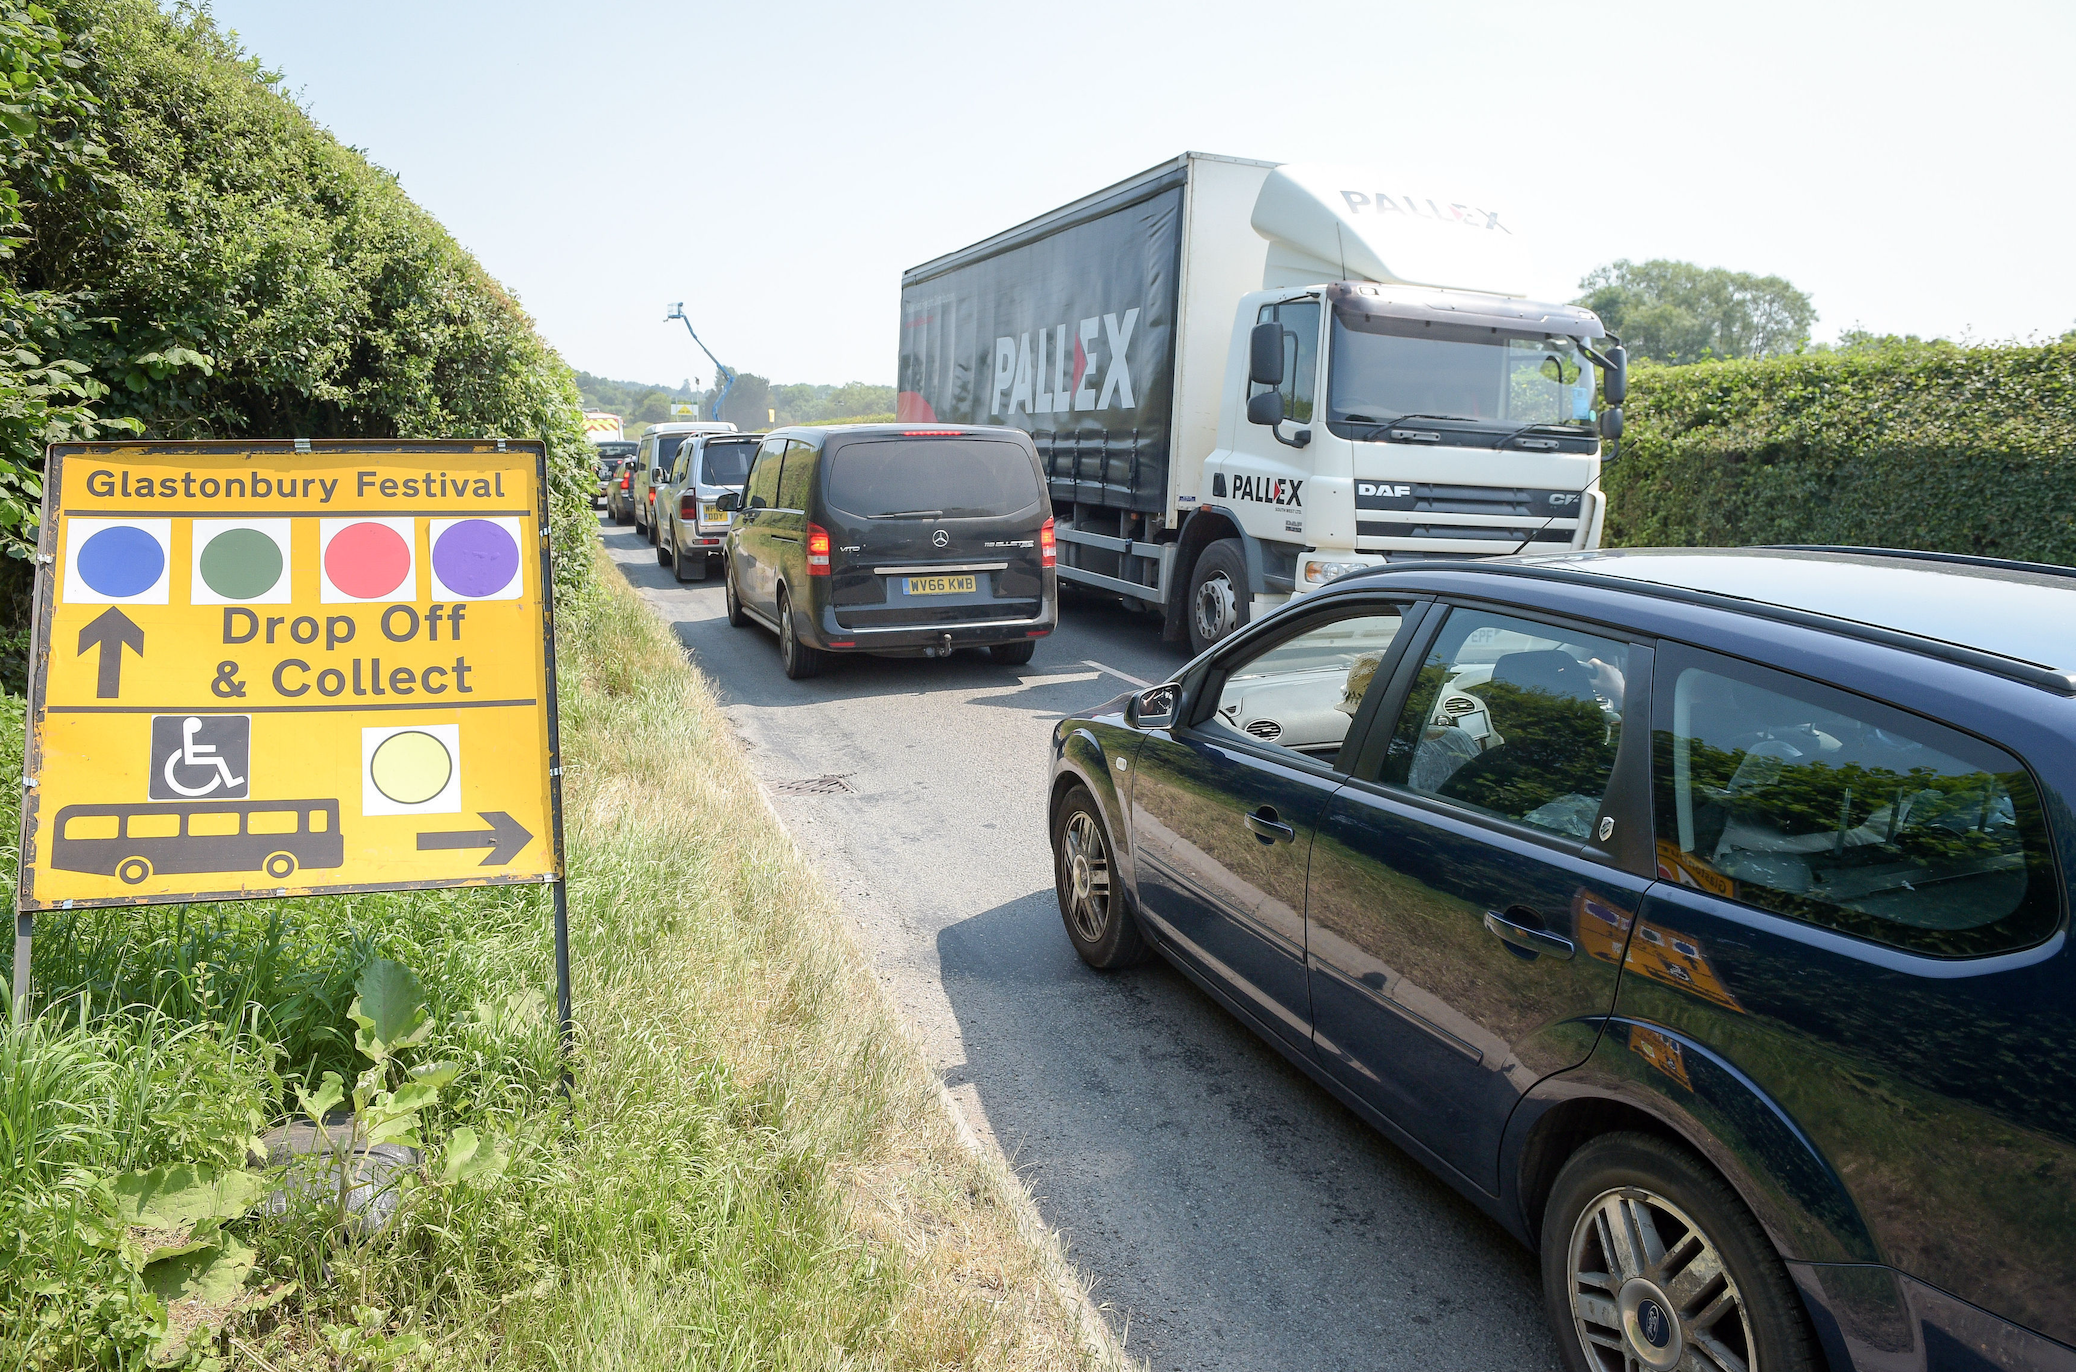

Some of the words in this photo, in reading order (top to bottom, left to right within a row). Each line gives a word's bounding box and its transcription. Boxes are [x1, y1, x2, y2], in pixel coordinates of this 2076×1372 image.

[1340, 190, 1513, 235] PALLEX
[991, 307, 1140, 415] PALLEX
[86, 469, 338, 503] Glastonbury
[356, 470, 505, 499] Festival
[1232, 474, 1303, 507] PALLEX
[1358, 483, 1411, 498] DAF
[1548, 494, 1580, 506] CF
[708, 512, 724, 520] DDY
[910, 579, 945, 592] WV66
[948, 578, 973, 590] KWB
[222, 606, 356, 650] Drop
[381, 603, 467, 642] Off
[211, 660, 247, 698] &
[271, 656, 473, 697] Collect
